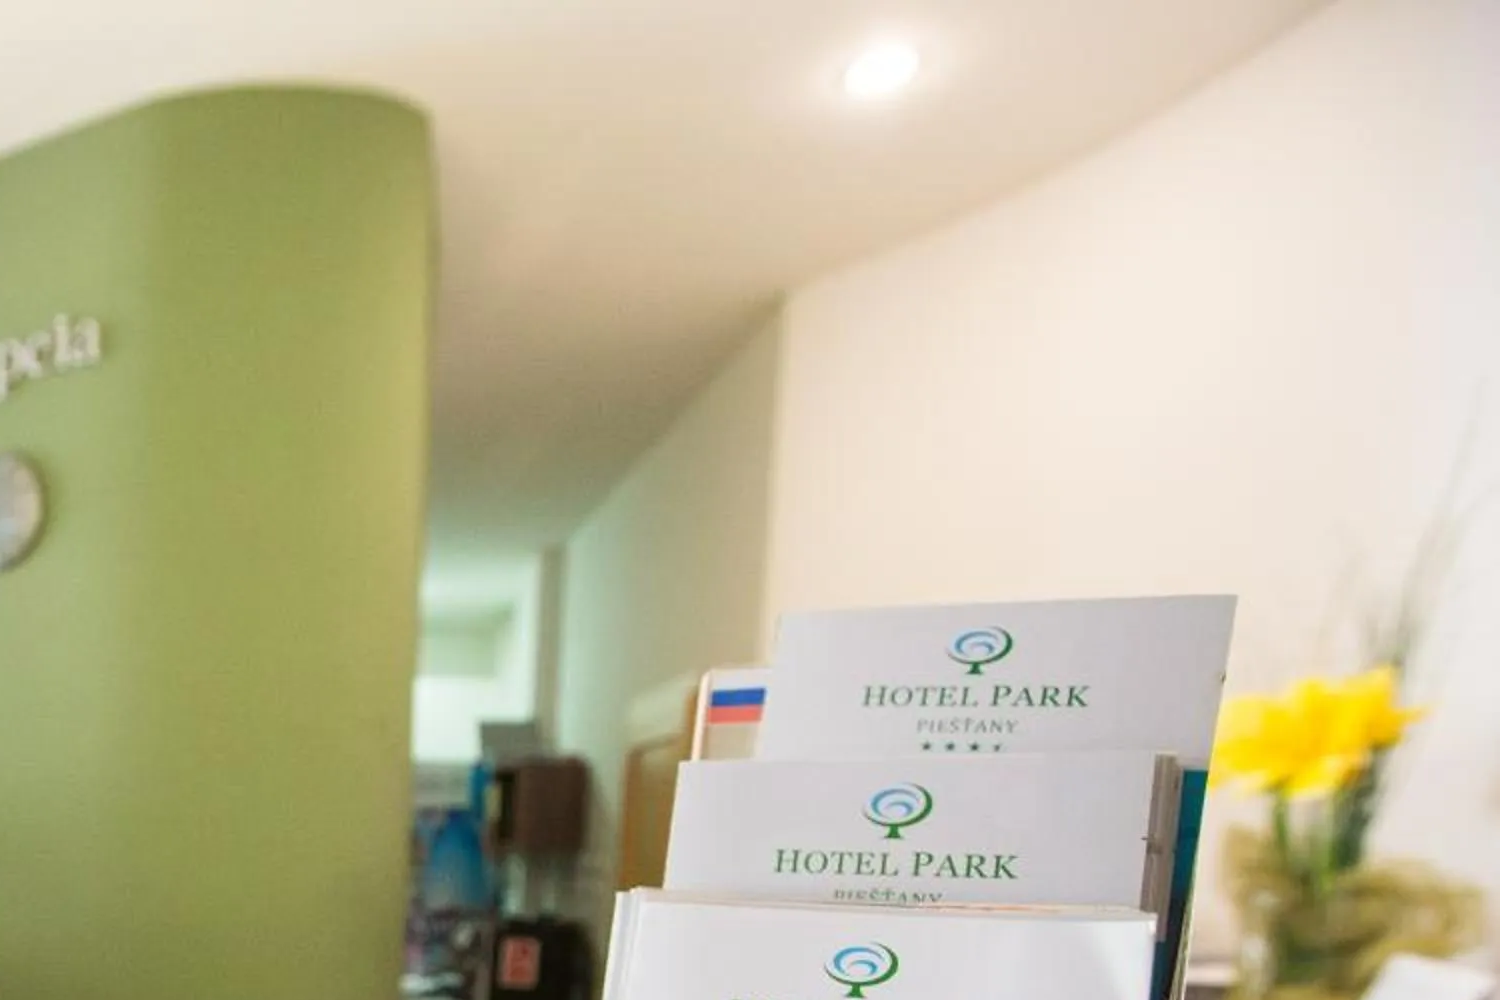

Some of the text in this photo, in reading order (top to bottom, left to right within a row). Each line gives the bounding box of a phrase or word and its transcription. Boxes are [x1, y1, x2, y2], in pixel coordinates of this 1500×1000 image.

[862, 685, 1090, 707] HOTEL PARK
[774, 848, 1019, 879] HOTEL PARK
